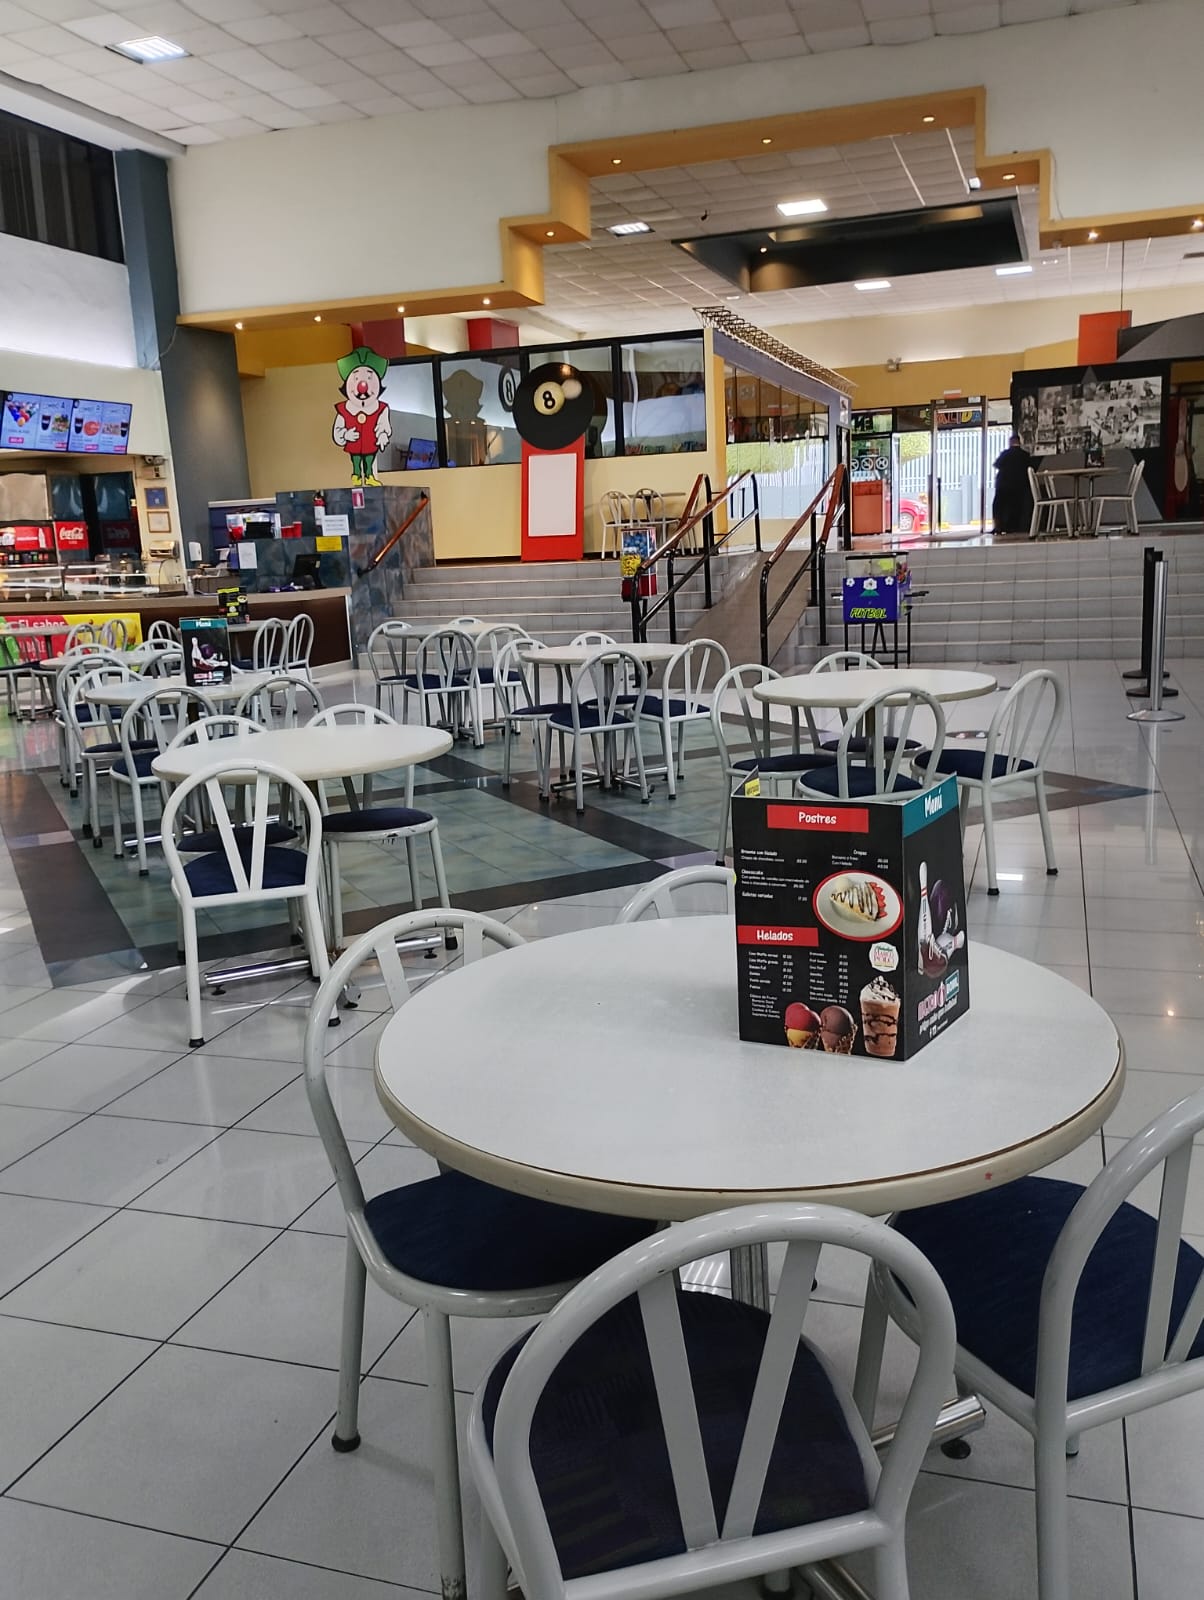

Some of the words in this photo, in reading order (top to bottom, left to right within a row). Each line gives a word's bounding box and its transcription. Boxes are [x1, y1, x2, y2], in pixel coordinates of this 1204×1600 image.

[542, 390, 556, 409] 8
[849, 607, 888, 619] FUTBOL
[924, 786, 943, 819] Menú
[798, 811, 837, 825] Postres
[756, 929, 794, 941] Helados
